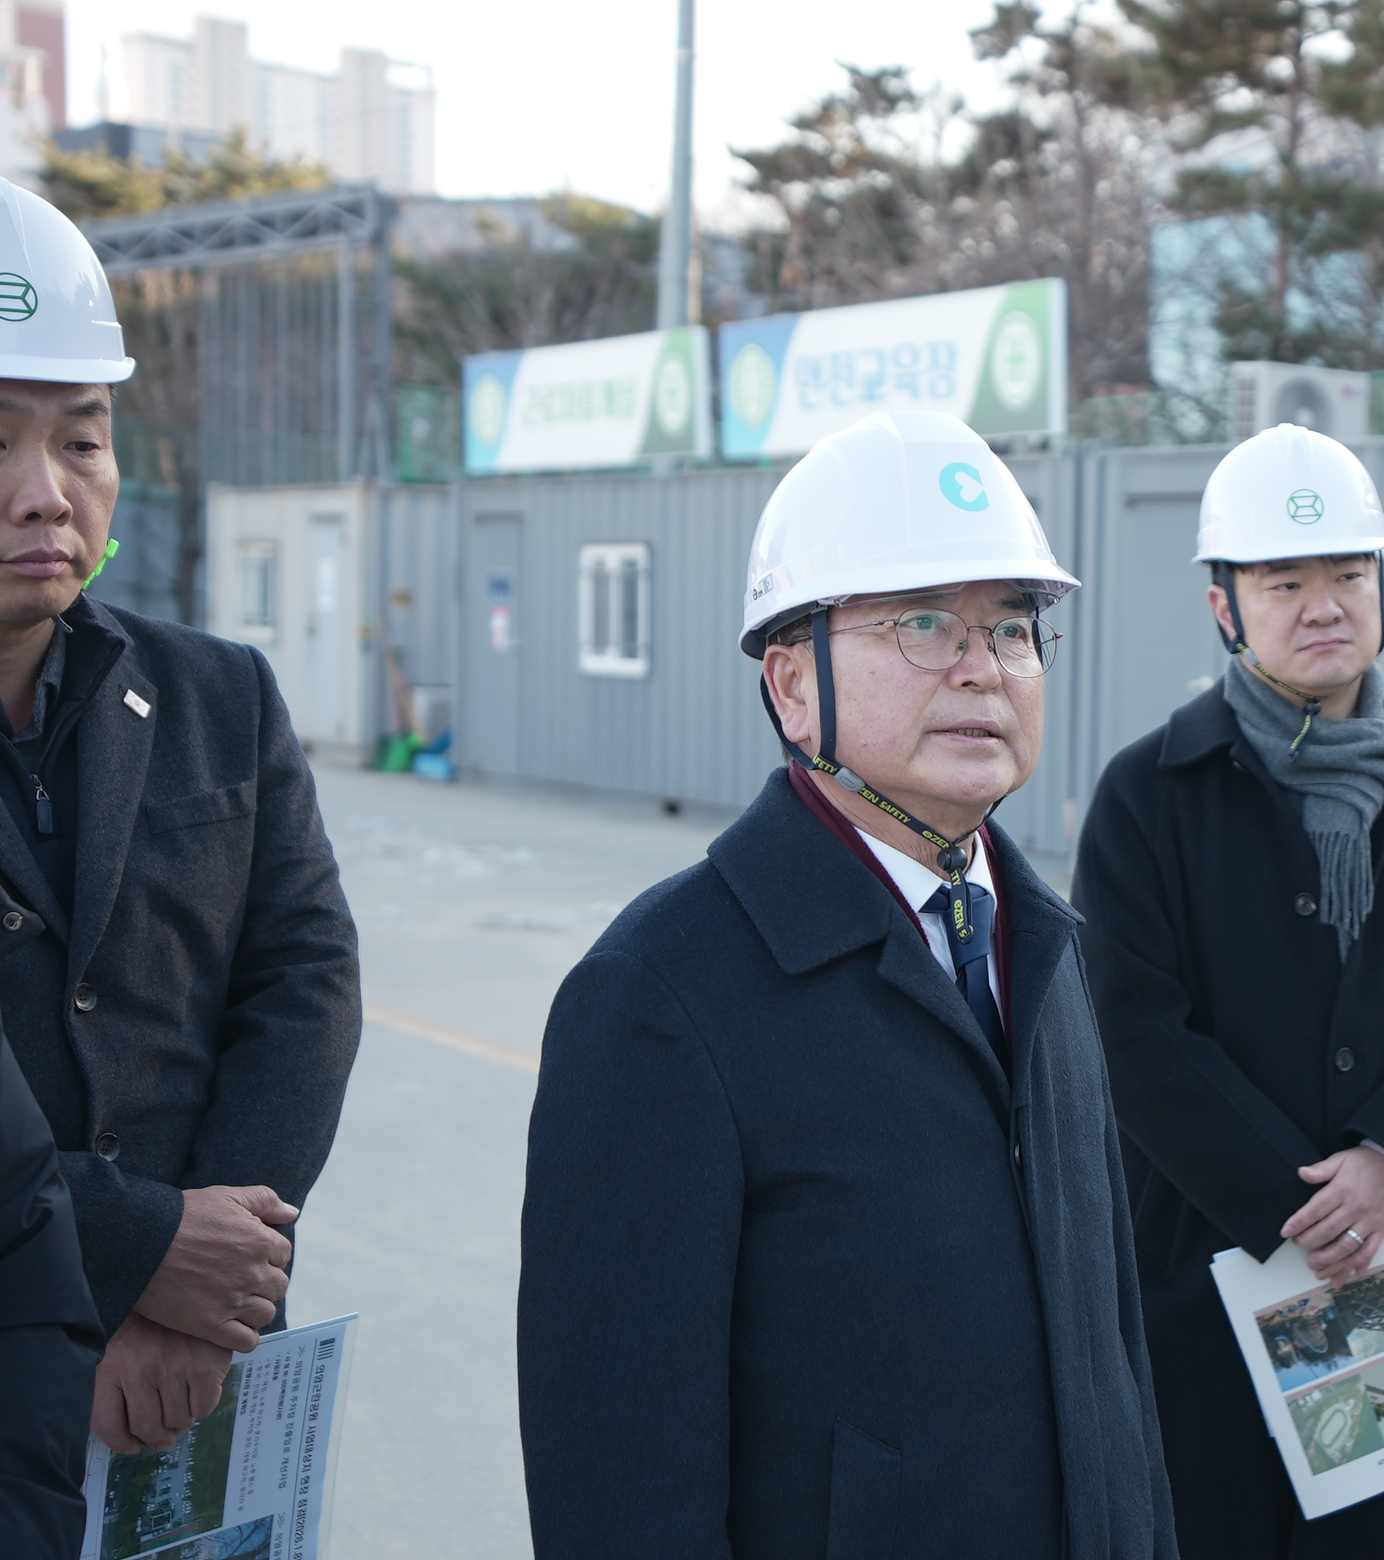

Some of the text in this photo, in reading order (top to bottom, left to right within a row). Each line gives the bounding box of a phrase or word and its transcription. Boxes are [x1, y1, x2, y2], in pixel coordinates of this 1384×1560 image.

[797, 338, 957, 411] 안전교육장
[879, 801, 912, 824] SAFETY
[287, 1396, 297, 1418] 주차장
[302, 1426, 316, 1472] 사업대상지
[299, 1476, 309, 1494] 현장
[293, 1499, 307, 1560] 점검(2026.1.8
